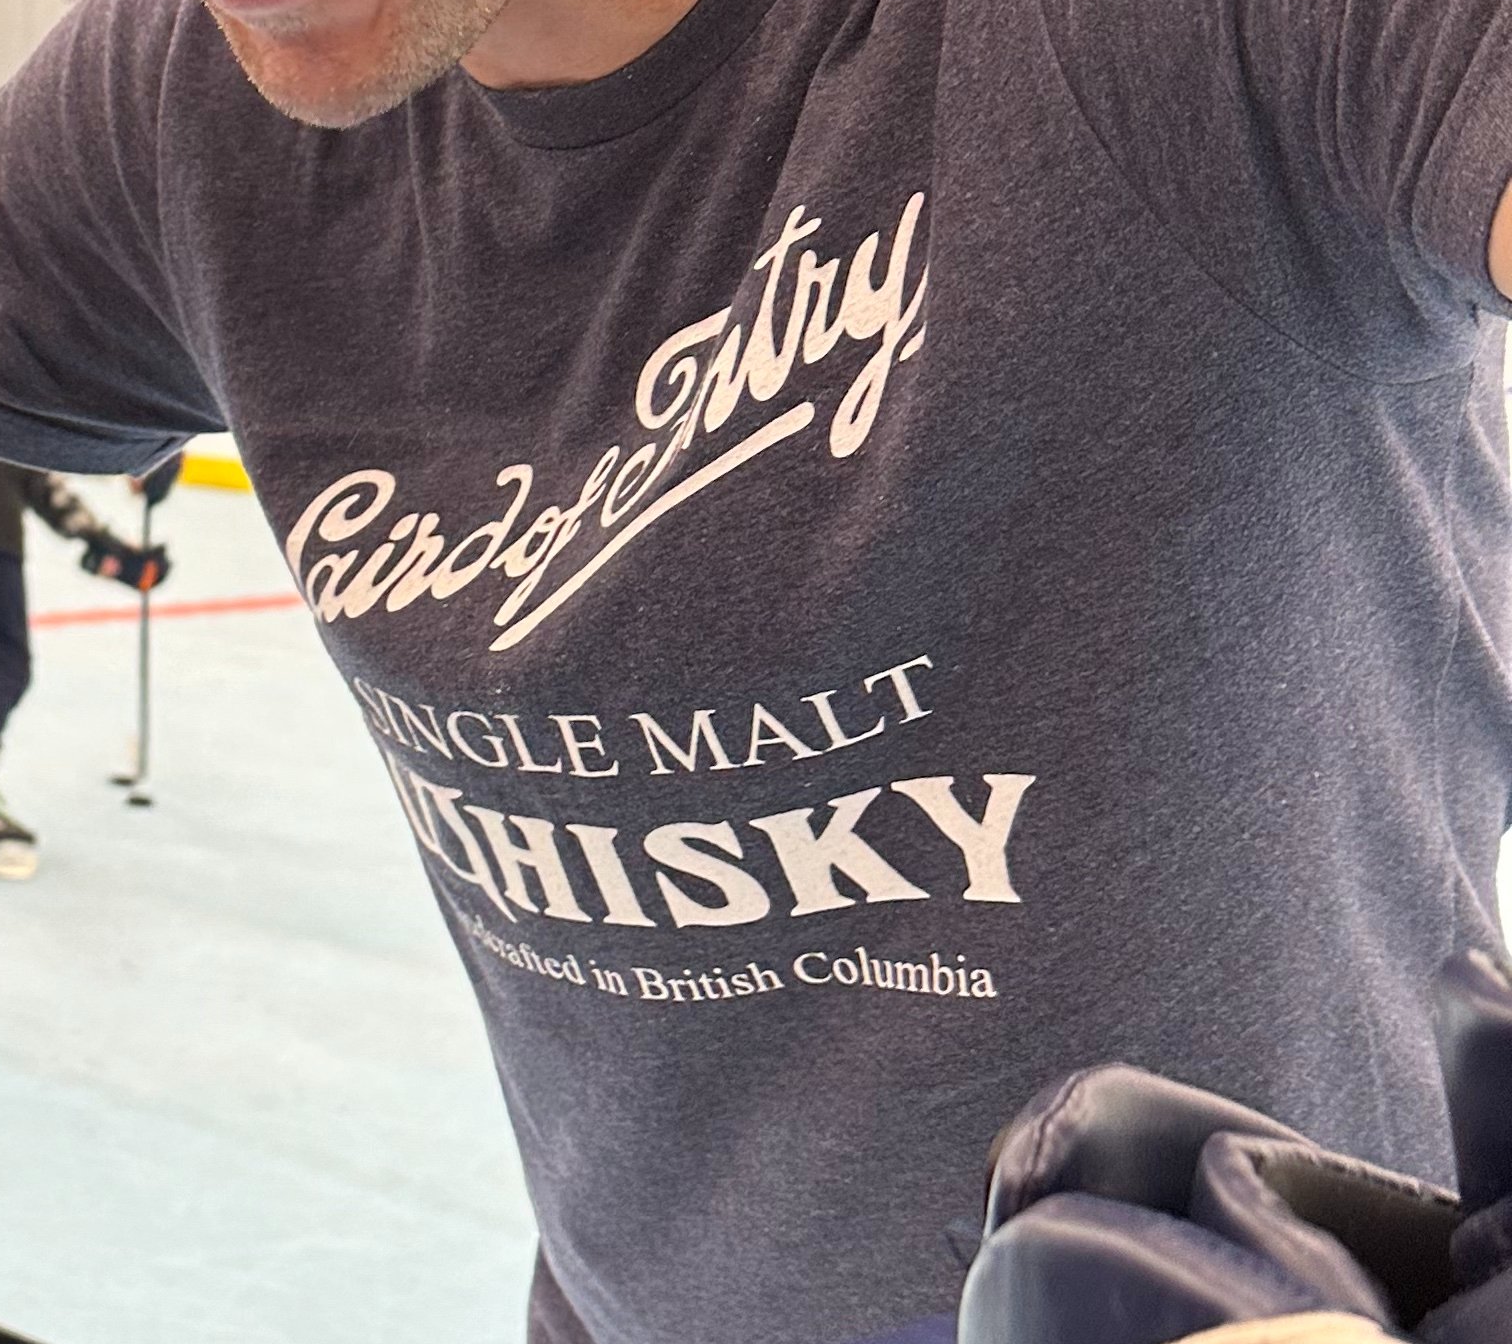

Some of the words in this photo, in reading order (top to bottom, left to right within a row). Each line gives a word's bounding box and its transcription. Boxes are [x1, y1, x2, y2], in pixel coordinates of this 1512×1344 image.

[354, 677, 620, 778] SINGLE
[629, 656, 934, 776] MALT
[387, 753, 1037, 929] WHISKY
[450, 902, 587, 986] dcrafted
[589, 959, 629, 997] in
[631, 962, 785, 1003] British
[793, 947, 998, 998] Columbia
